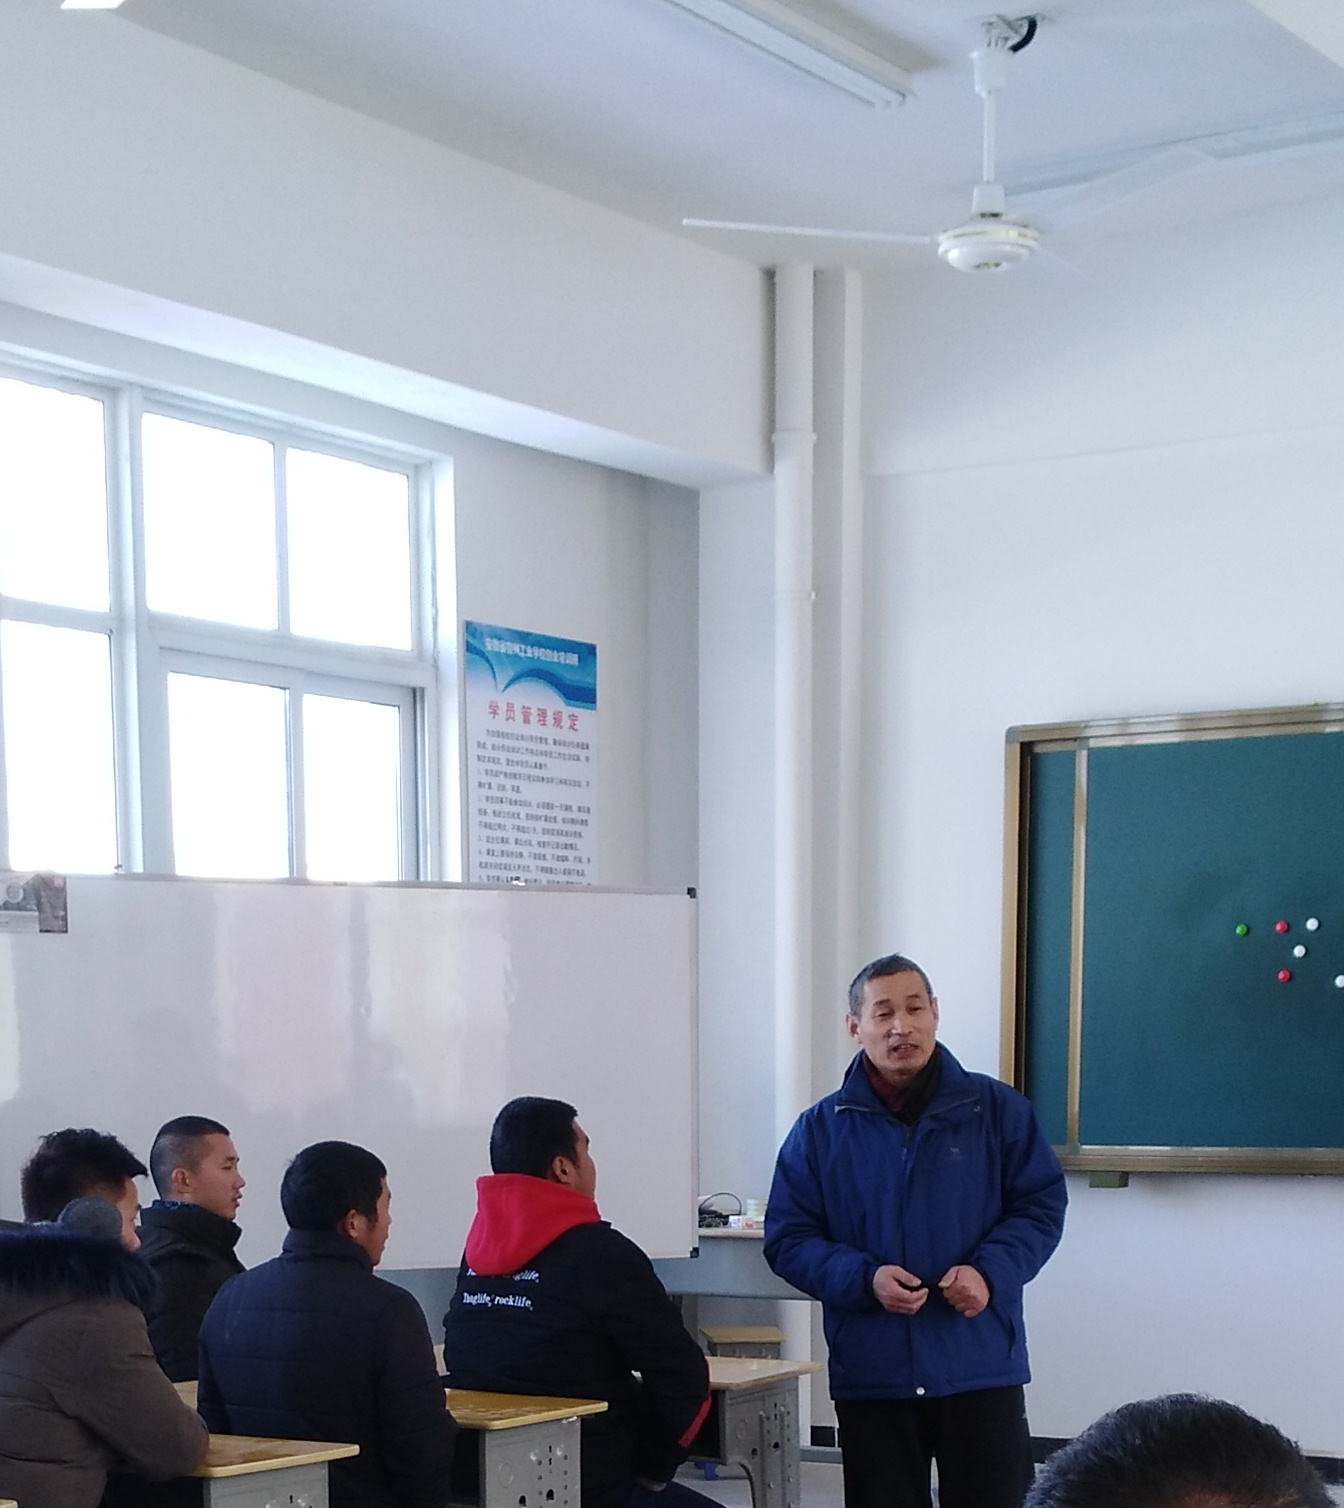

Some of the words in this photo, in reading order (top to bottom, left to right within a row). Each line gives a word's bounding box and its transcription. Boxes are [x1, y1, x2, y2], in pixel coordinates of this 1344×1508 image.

[488, 701, 579, 732] 学员管理规定
